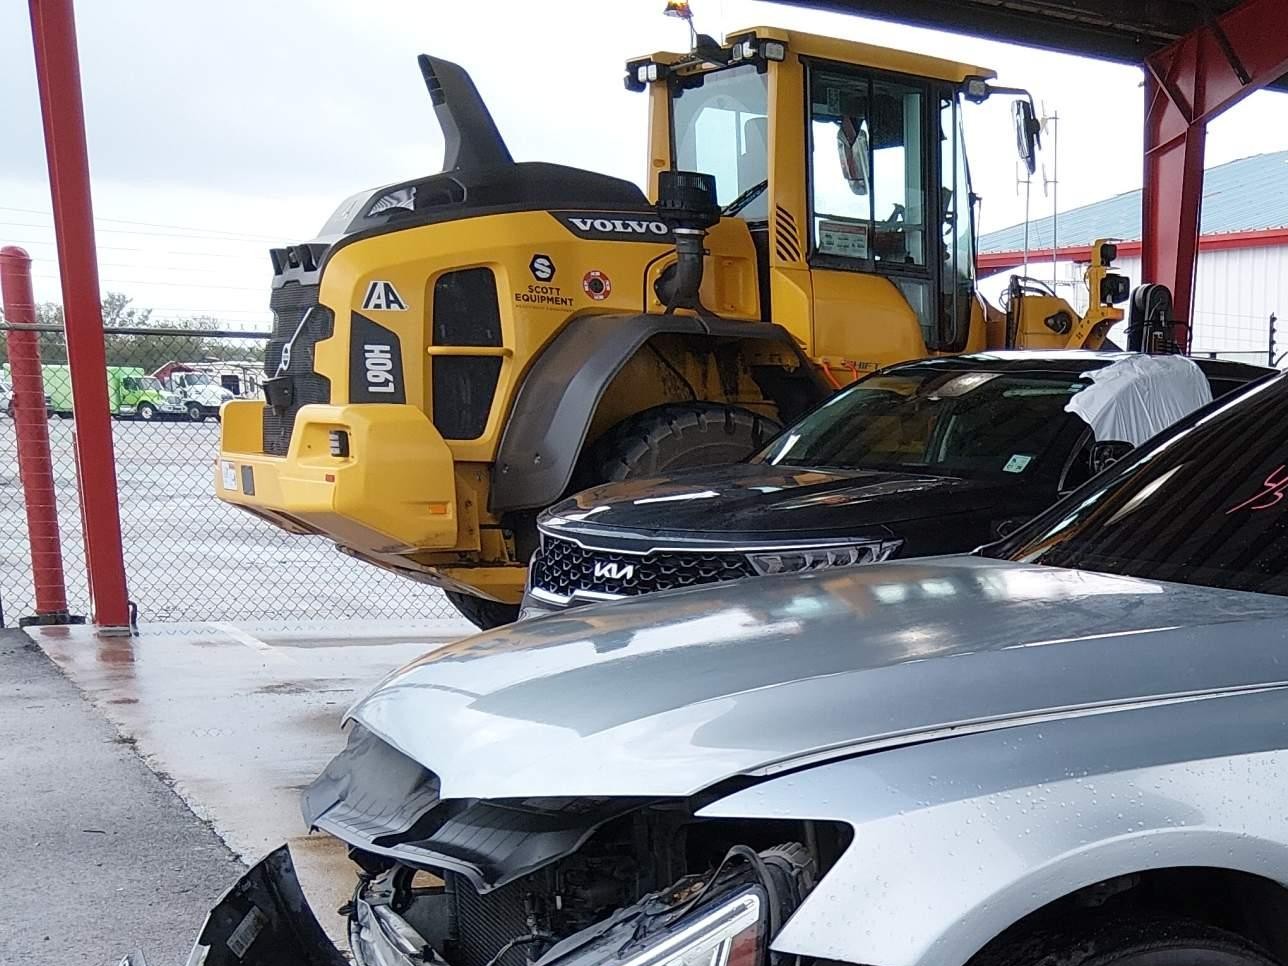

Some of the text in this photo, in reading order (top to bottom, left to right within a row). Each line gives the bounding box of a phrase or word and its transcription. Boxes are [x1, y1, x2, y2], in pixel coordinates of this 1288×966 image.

[568, 218, 669, 235] VOLVO
[527, 285, 561, 296] SCOTT
[514, 293, 574, 306] EQUIPMENT
